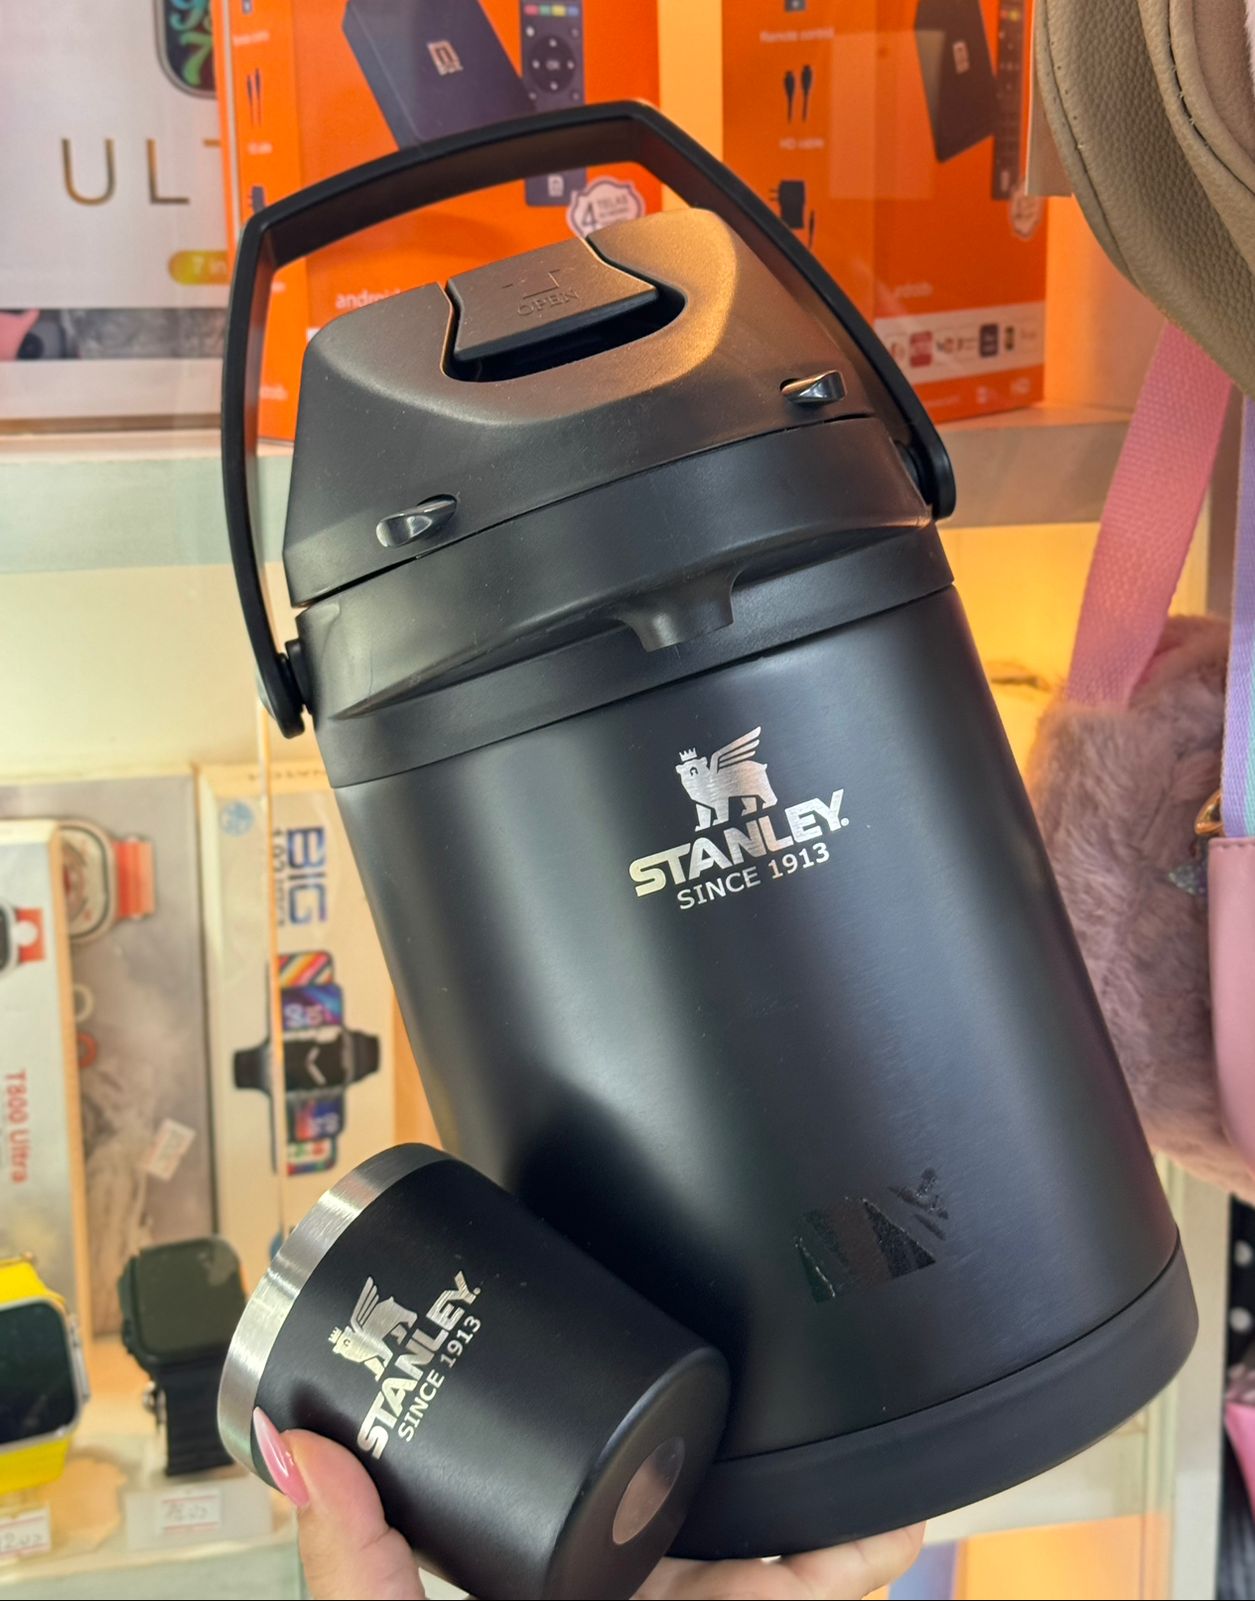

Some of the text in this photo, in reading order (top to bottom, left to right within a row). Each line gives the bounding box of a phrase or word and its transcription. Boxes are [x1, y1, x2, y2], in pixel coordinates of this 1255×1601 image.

[517, 287, 579, 316] OPEN
[286, 826, 328, 925] BIG
[676, 841, 831, 910] SINCE 1913
[5, 1068, 29, 1124] T800
[397, 1315, 482, 1443] SINCE 1913
